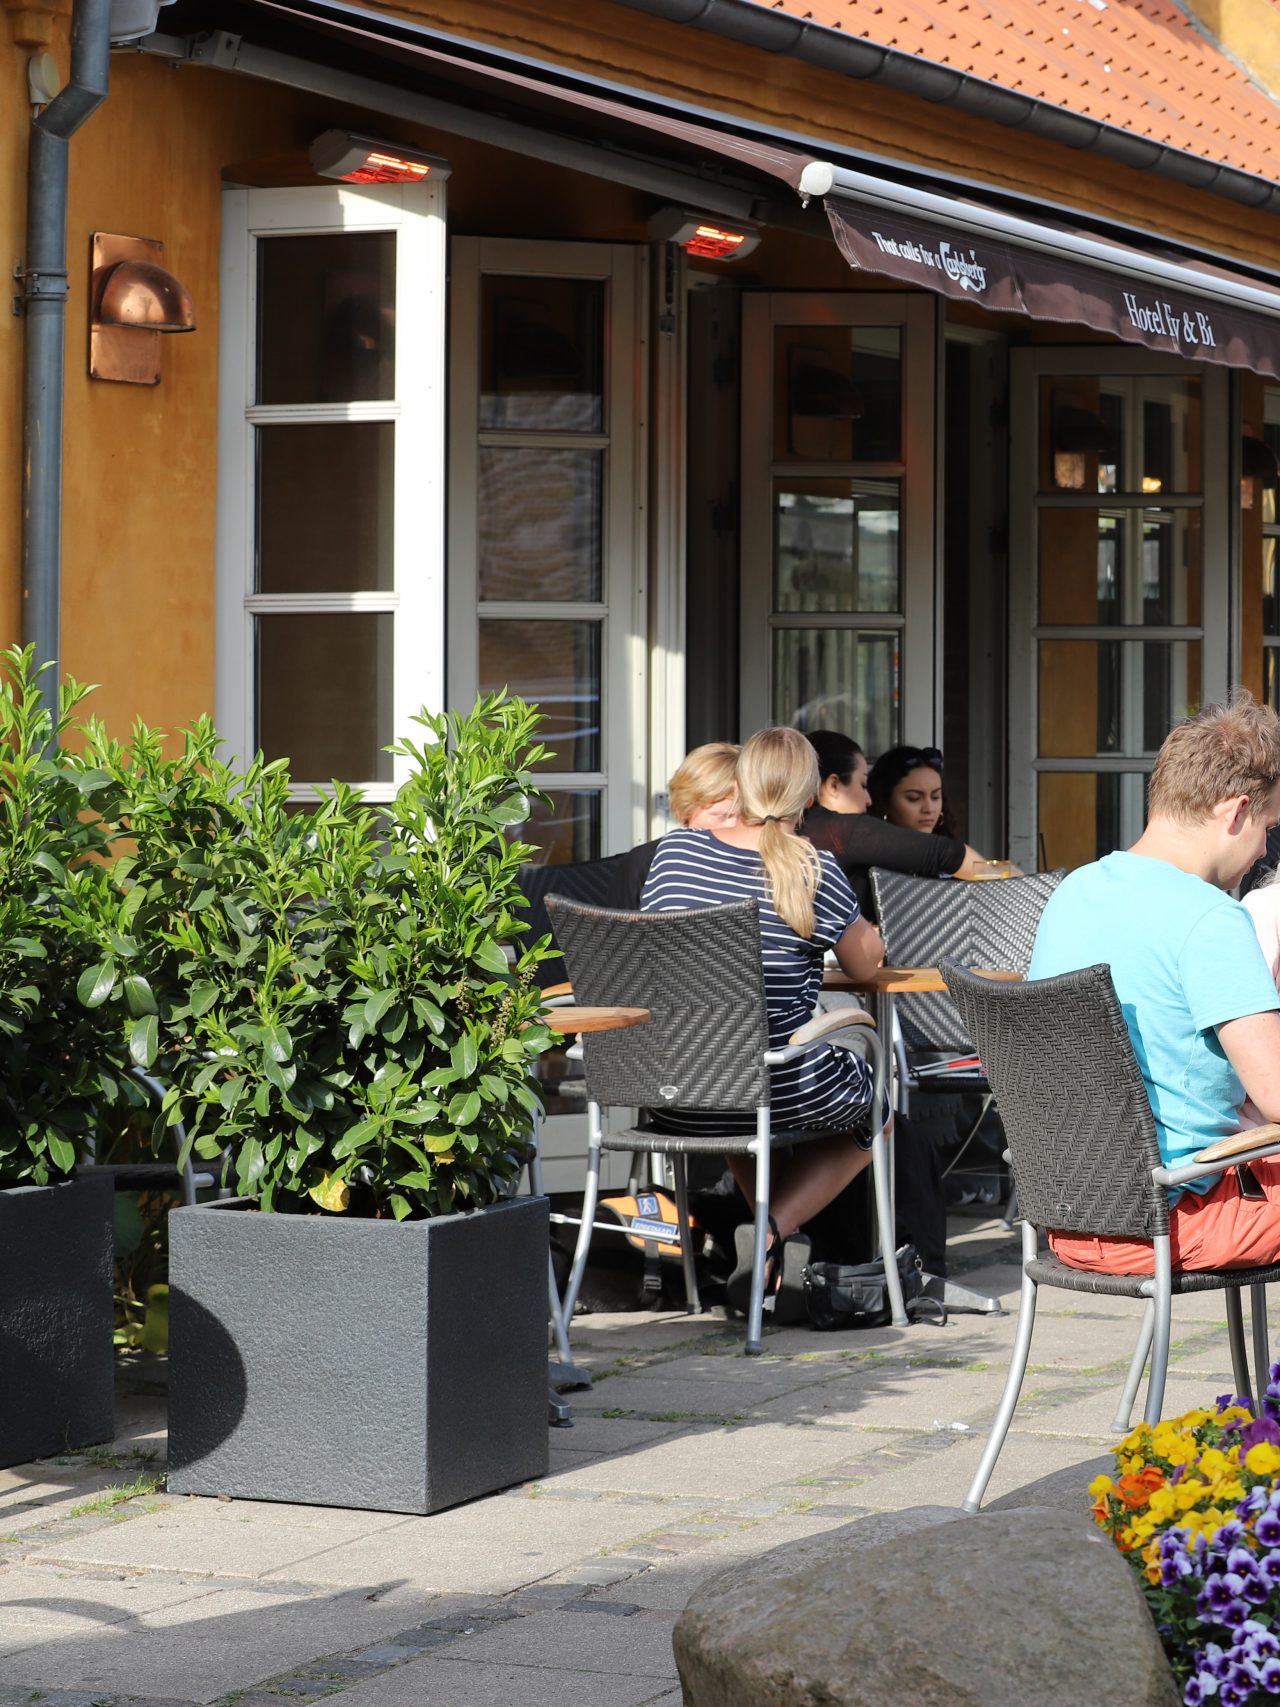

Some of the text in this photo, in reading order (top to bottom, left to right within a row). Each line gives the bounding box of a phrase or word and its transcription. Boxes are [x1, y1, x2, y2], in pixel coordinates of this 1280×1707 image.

[871, 231, 987, 293] That calls for a Carlsberg
[1122, 292, 1217, 347] Hotel Fy & Bi
